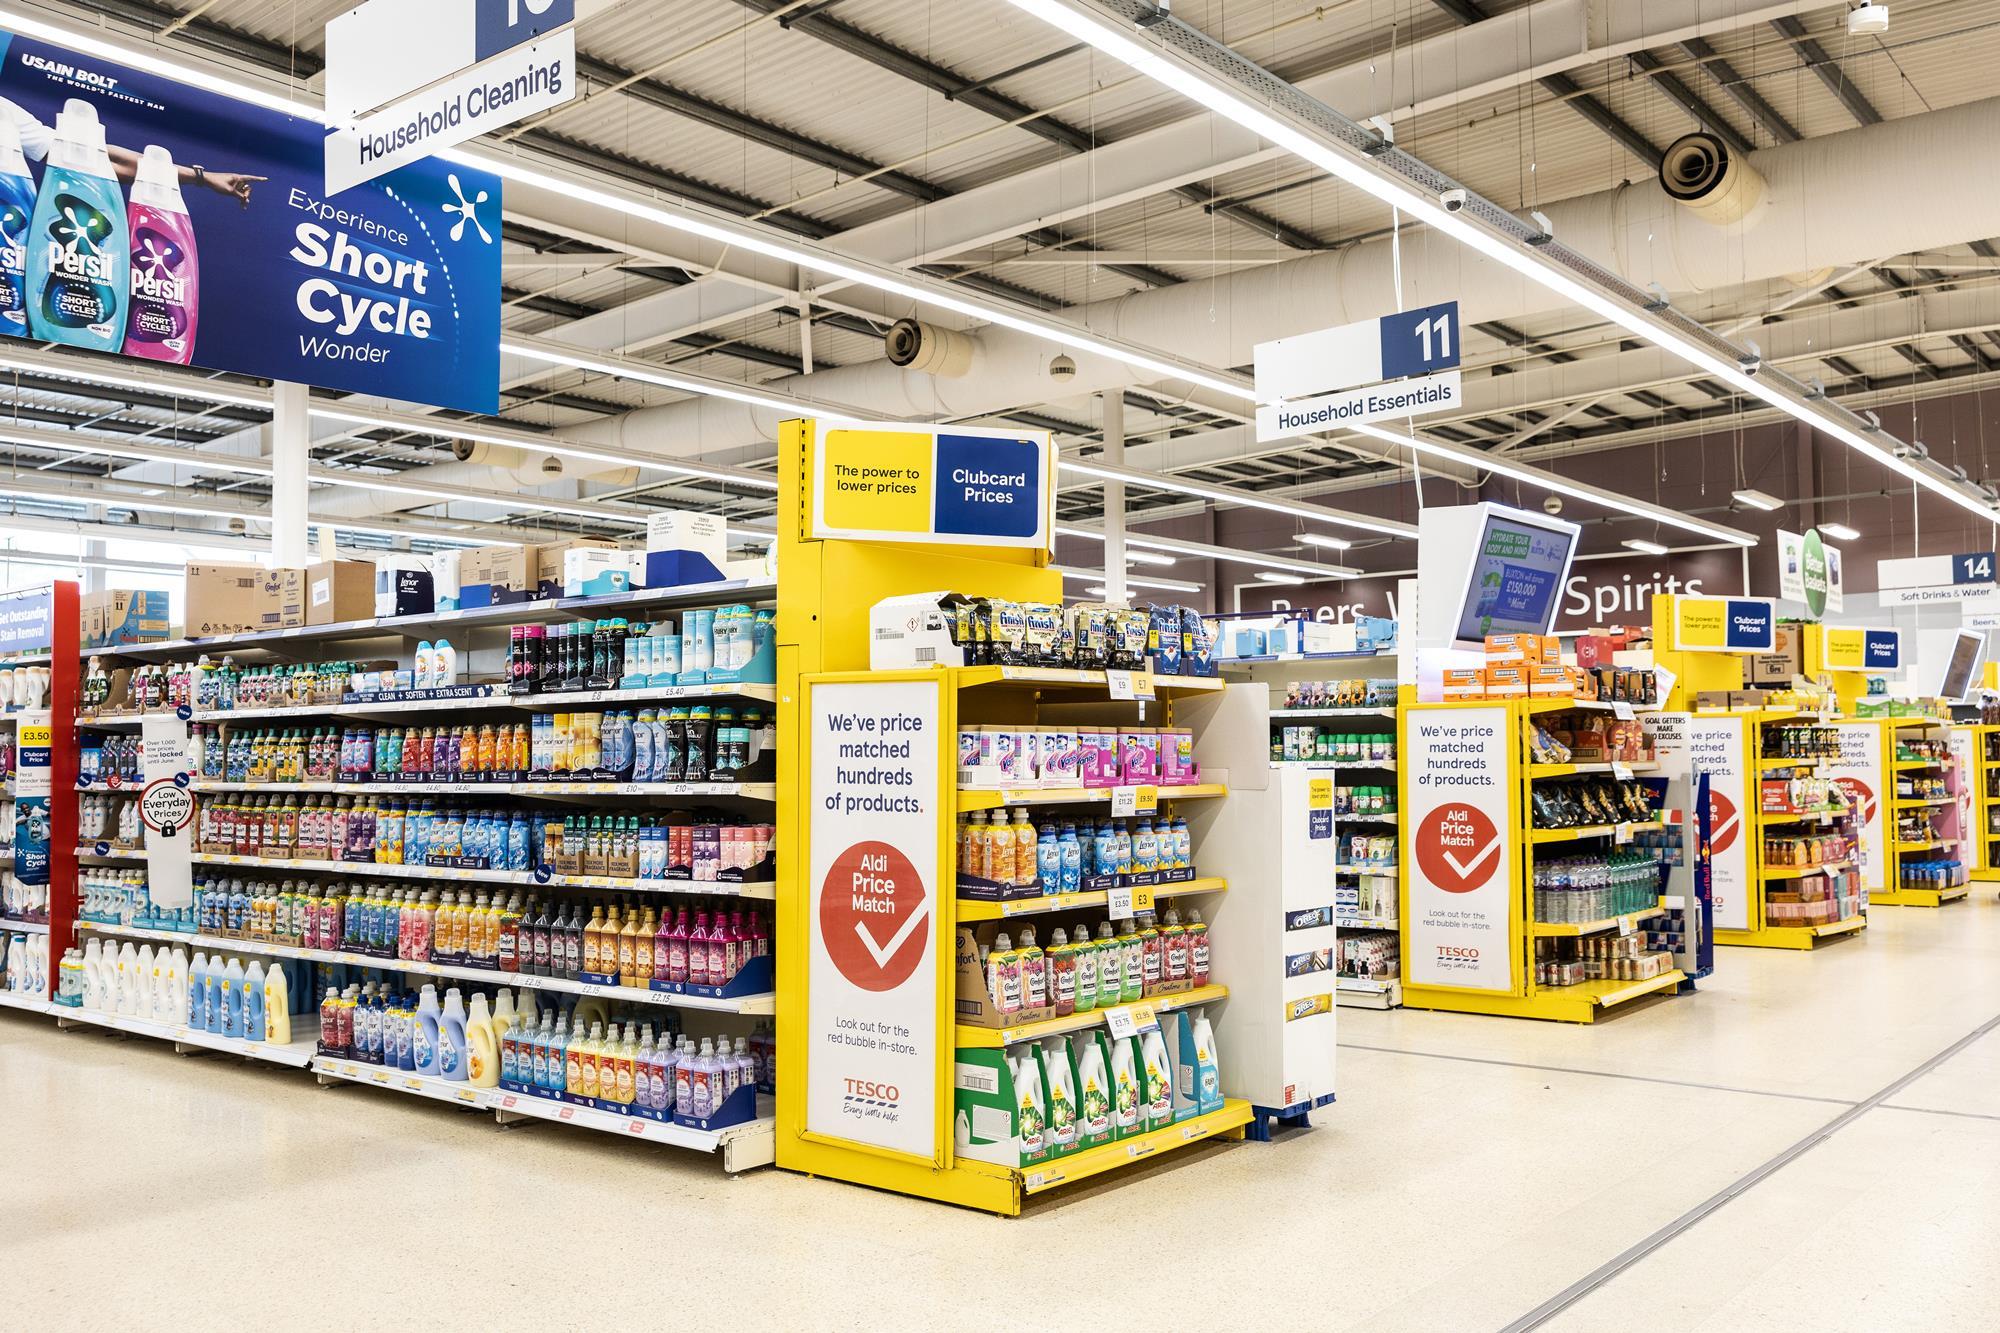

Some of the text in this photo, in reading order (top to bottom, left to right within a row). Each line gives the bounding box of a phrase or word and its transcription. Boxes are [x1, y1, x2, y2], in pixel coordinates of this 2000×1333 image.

[21, 53, 118, 90] USAIN BOLT
[47, 73, 165, 111] THE WORLD'S FASTEST MAN
[360, 59, 562, 165] Household Cleaning
[288, 187, 408, 246] Experience
[49, 241, 114, 281] Persil
[289, 222, 429, 295] Short
[55, 270, 113, 287] WONDER WASH
[131, 267, 185, 301] Persil
[61, 294, 97, 308] SHORT
[136, 293, 165, 304] WONDER
[60, 302, 97, 317] CYCLES
[296, 278, 432, 339] Cycle
[140, 314, 171, 326] SHORT
[139, 322, 172, 333] CYCLES
[1415, 313, 1450, 362] 11
[299, 335, 390, 363] Wonder
[1278, 384, 1451, 430] Household Essentials
[834, 465, 920, 479] The power to
[952, 469, 1026, 488] Clubcard
[837, 480, 917, 494] lower prices
[964, 487, 1014, 504] Prices
[1964, 557, 1991, 579] 14
[400, 577, 419, 588] Lenor
[1506, 581, 1537, 597] £150,000
[1901, 592, 1919, 601] Soft
[1922, 590, 1951, 600] Drinks
[1962, 588, 1991, 597] Water
[9, 606, 49, 623] Outstanding
[1000, 611, 1024, 626] finish
[1733, 616, 1766, 626] Clubcard
[1028, 615, 1055, 629] finish
[1739, 624, 1761, 633] Prices
[0, 623, 45, 642] Stain Removal
[1126, 622, 1146, 637] finish
[1870, 642, 1895, 651] Clubcard
[1874, 649, 1891, 657] Prices
[378, 691, 396, 702] CLEAN
[405, 689, 426, 700] SOFTEN
[436, 688, 454, 698] EXTRA
[454, 686, 473, 697] SCENT
[592, 691, 602, 701] £8
[828, 713, 923, 736] We've price
[1644, 717, 1686, 725] GOAL GETTERS
[23, 731, 50, 741] £3.50
[1461, 725, 1494, 739] price
[1658, 732, 1682, 740] EXCUSES.
[1704, 731, 1733, 742] price
[1847, 732, 1871, 740] price
[839, 740, 910, 758] matched
[1429, 741, 1484, 753] matched
[1427, 757, 1487, 769] hundreds
[837, 766, 913, 785] hundreds
[1418, 773, 1495, 787] of products.
[158, 791, 176, 799] Low
[626, 784, 638, 793] £10
[674, 784, 687, 793] £10
[143, 798, 191, 810] Everyday
[825, 792, 924, 816] of products.
[154, 810, 182, 818] Prices
[1446, 810, 1468, 822] Aldi
[1440, 821, 1474, 835] Price
[1139, 840, 1155, 850] Lenor
[1440, 835, 1475, 847] Match
[25, 853, 46, 862] Short
[26, 859, 46, 868] Cycle
[860, 854, 888, 873] Aldi
[852, 872, 895, 895] Price
[852, 894, 895, 914] Match
[1138, 895, 1147, 905] £3
[1295, 913, 1317, 927] OREO
[1428, 909, 1445, 917] Look
[1461, 911, 1471, 919] for
[1473, 912, 1486, 920] the
[1342, 919, 1352, 927] £2
[1436, 920, 1460, 928] bubble
[1436, 946, 1479, 958] TESCO
[1291, 953, 1311, 969] OREO
[651, 993, 671, 1003] £2.15
[1293, 1001, 1315, 1017] OREO
[1015, 1012, 1041, 1024] Creations
[836, 1016, 910, 1038] Look out for the
[827, 1033, 918, 1056] red bubble in-store.
[844, 1078, 900, 1102] TESCO
[1152, 1101, 1169, 1111] ARIEL
[1124, 1109, 1137, 1119] ARIEL
[1092, 1118, 1107, 1129] ARIEL
[1058, 1127, 1074, 1137] ARIEL
[1026, 1135, 1042, 1146] ARIEL
